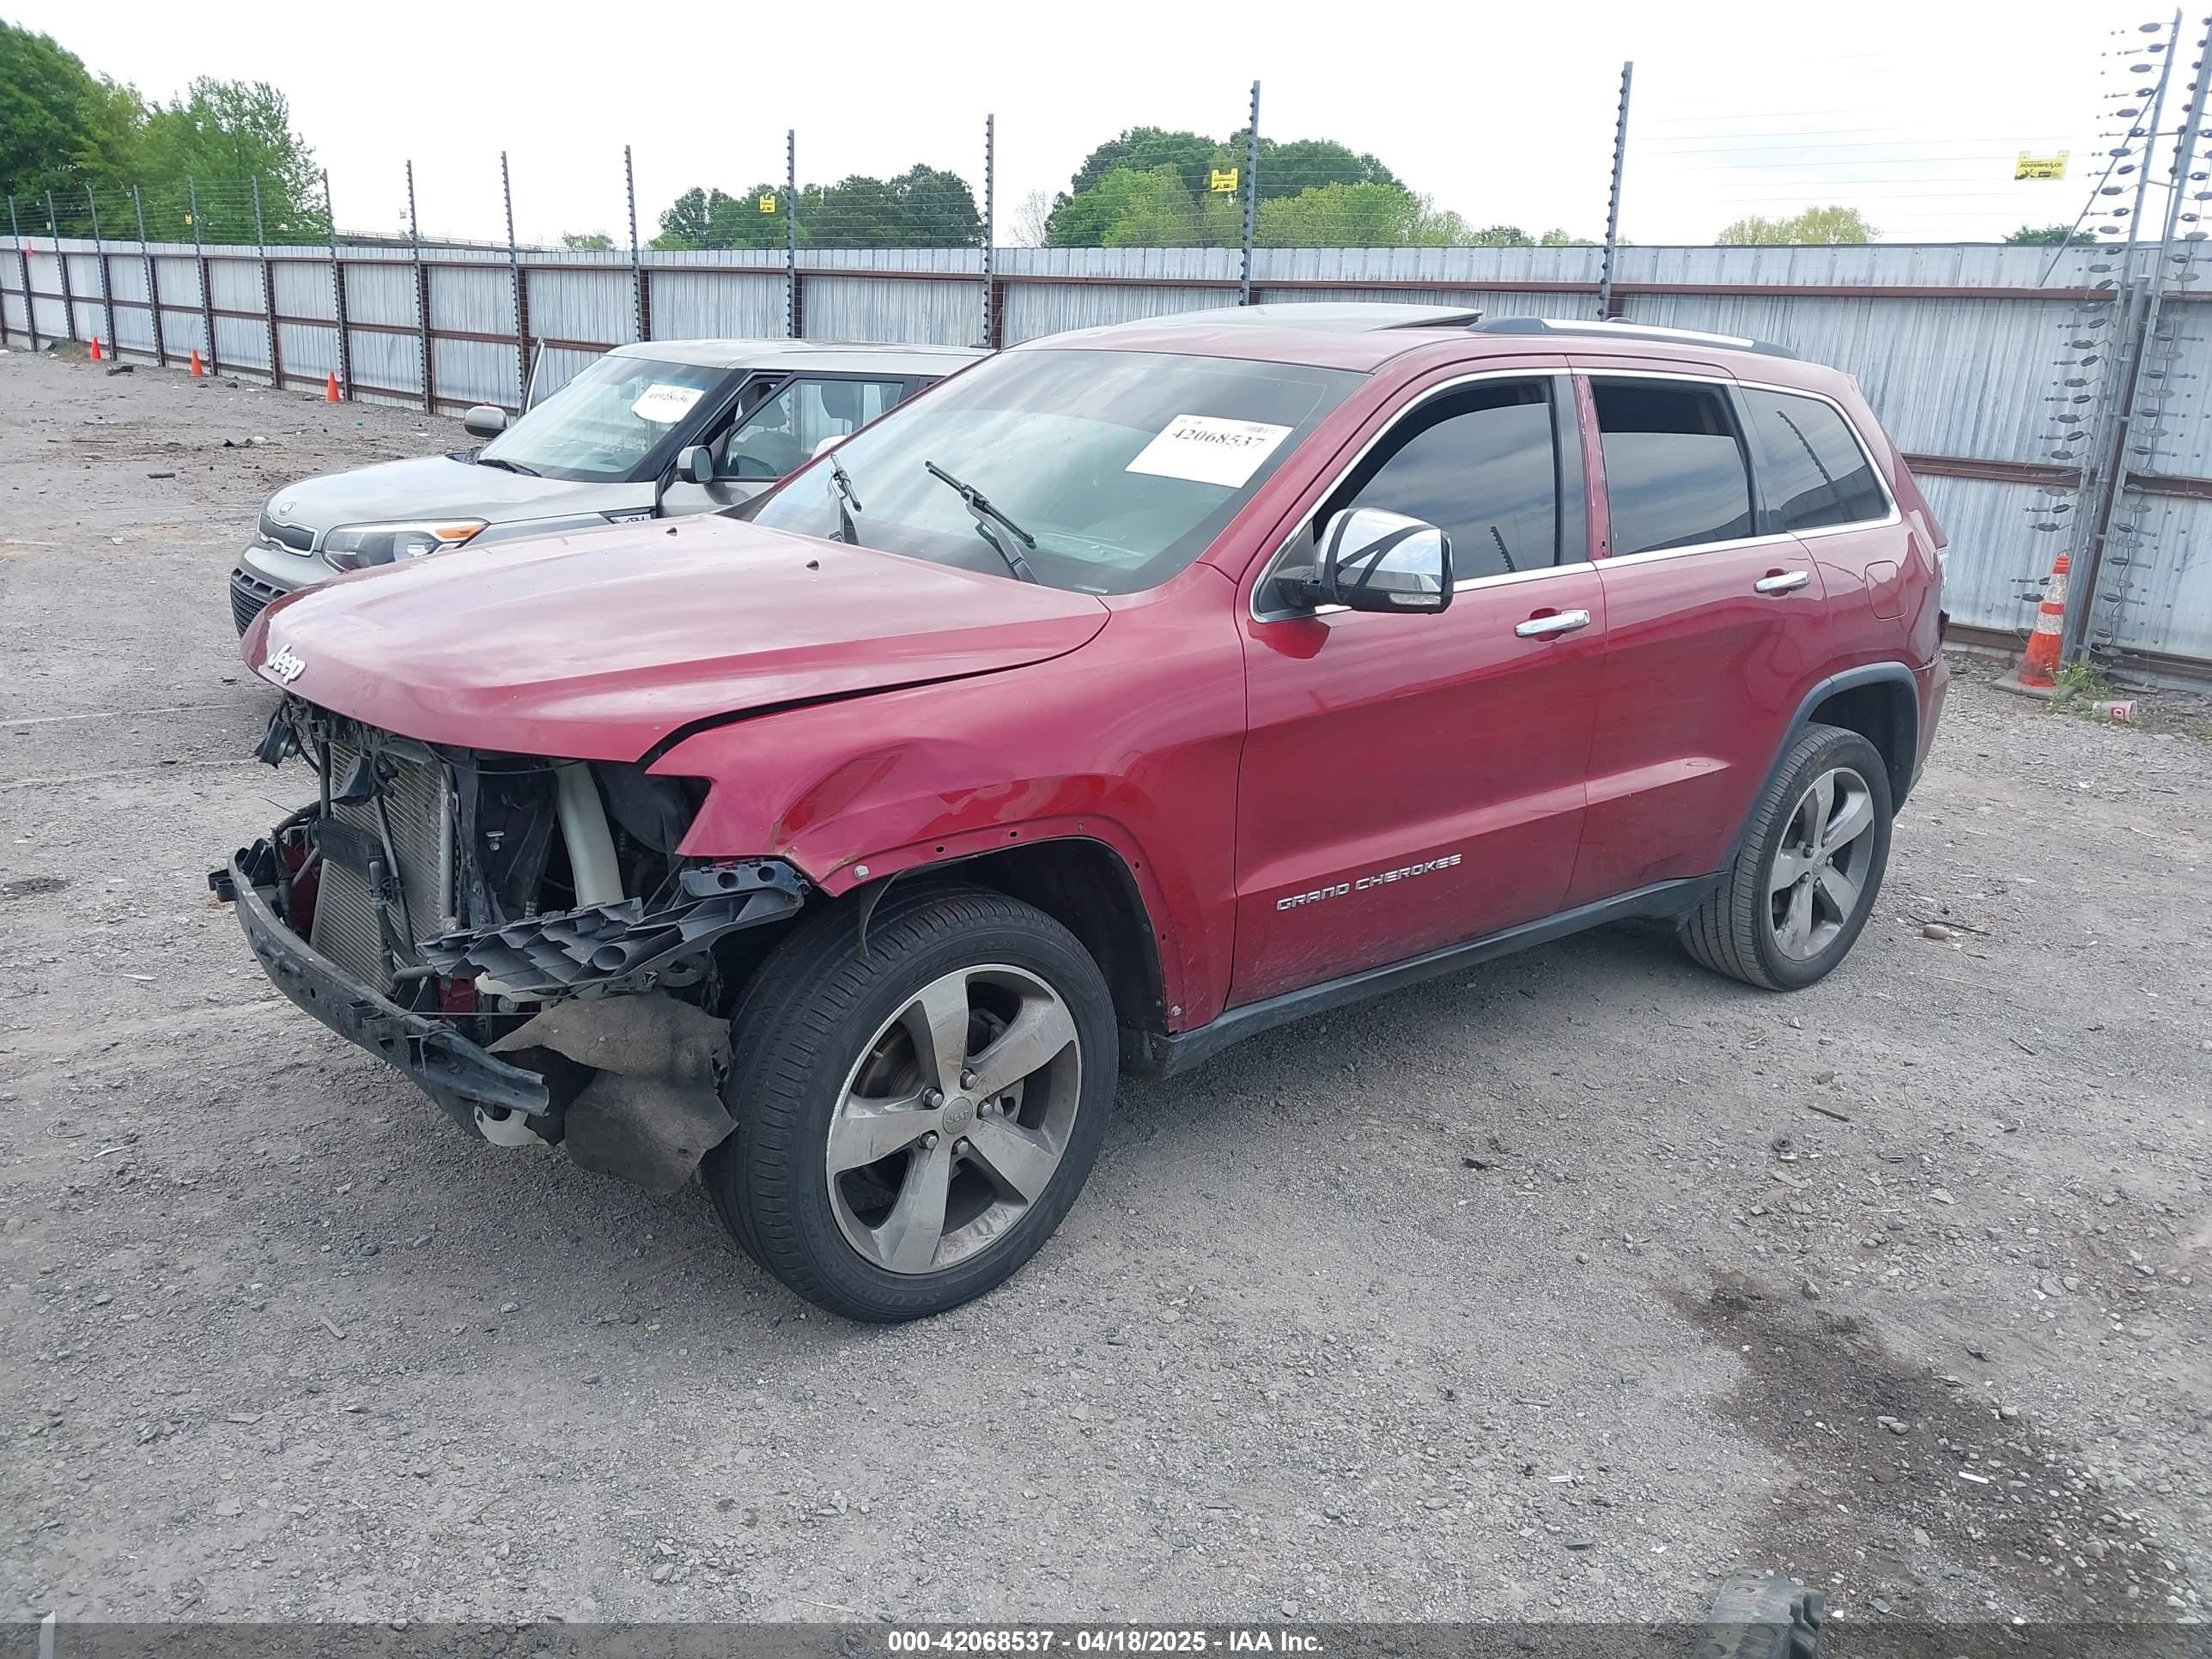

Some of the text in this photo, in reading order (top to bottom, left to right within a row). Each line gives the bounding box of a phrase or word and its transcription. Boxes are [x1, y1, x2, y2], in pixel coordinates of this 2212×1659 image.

[1172, 428, 1266, 448] 42068537
[267, 644, 306, 684] Jeep
[1276, 854, 1462, 911] GRAND CHEROKEE
[946, 1109, 969, 1125] Jeep
